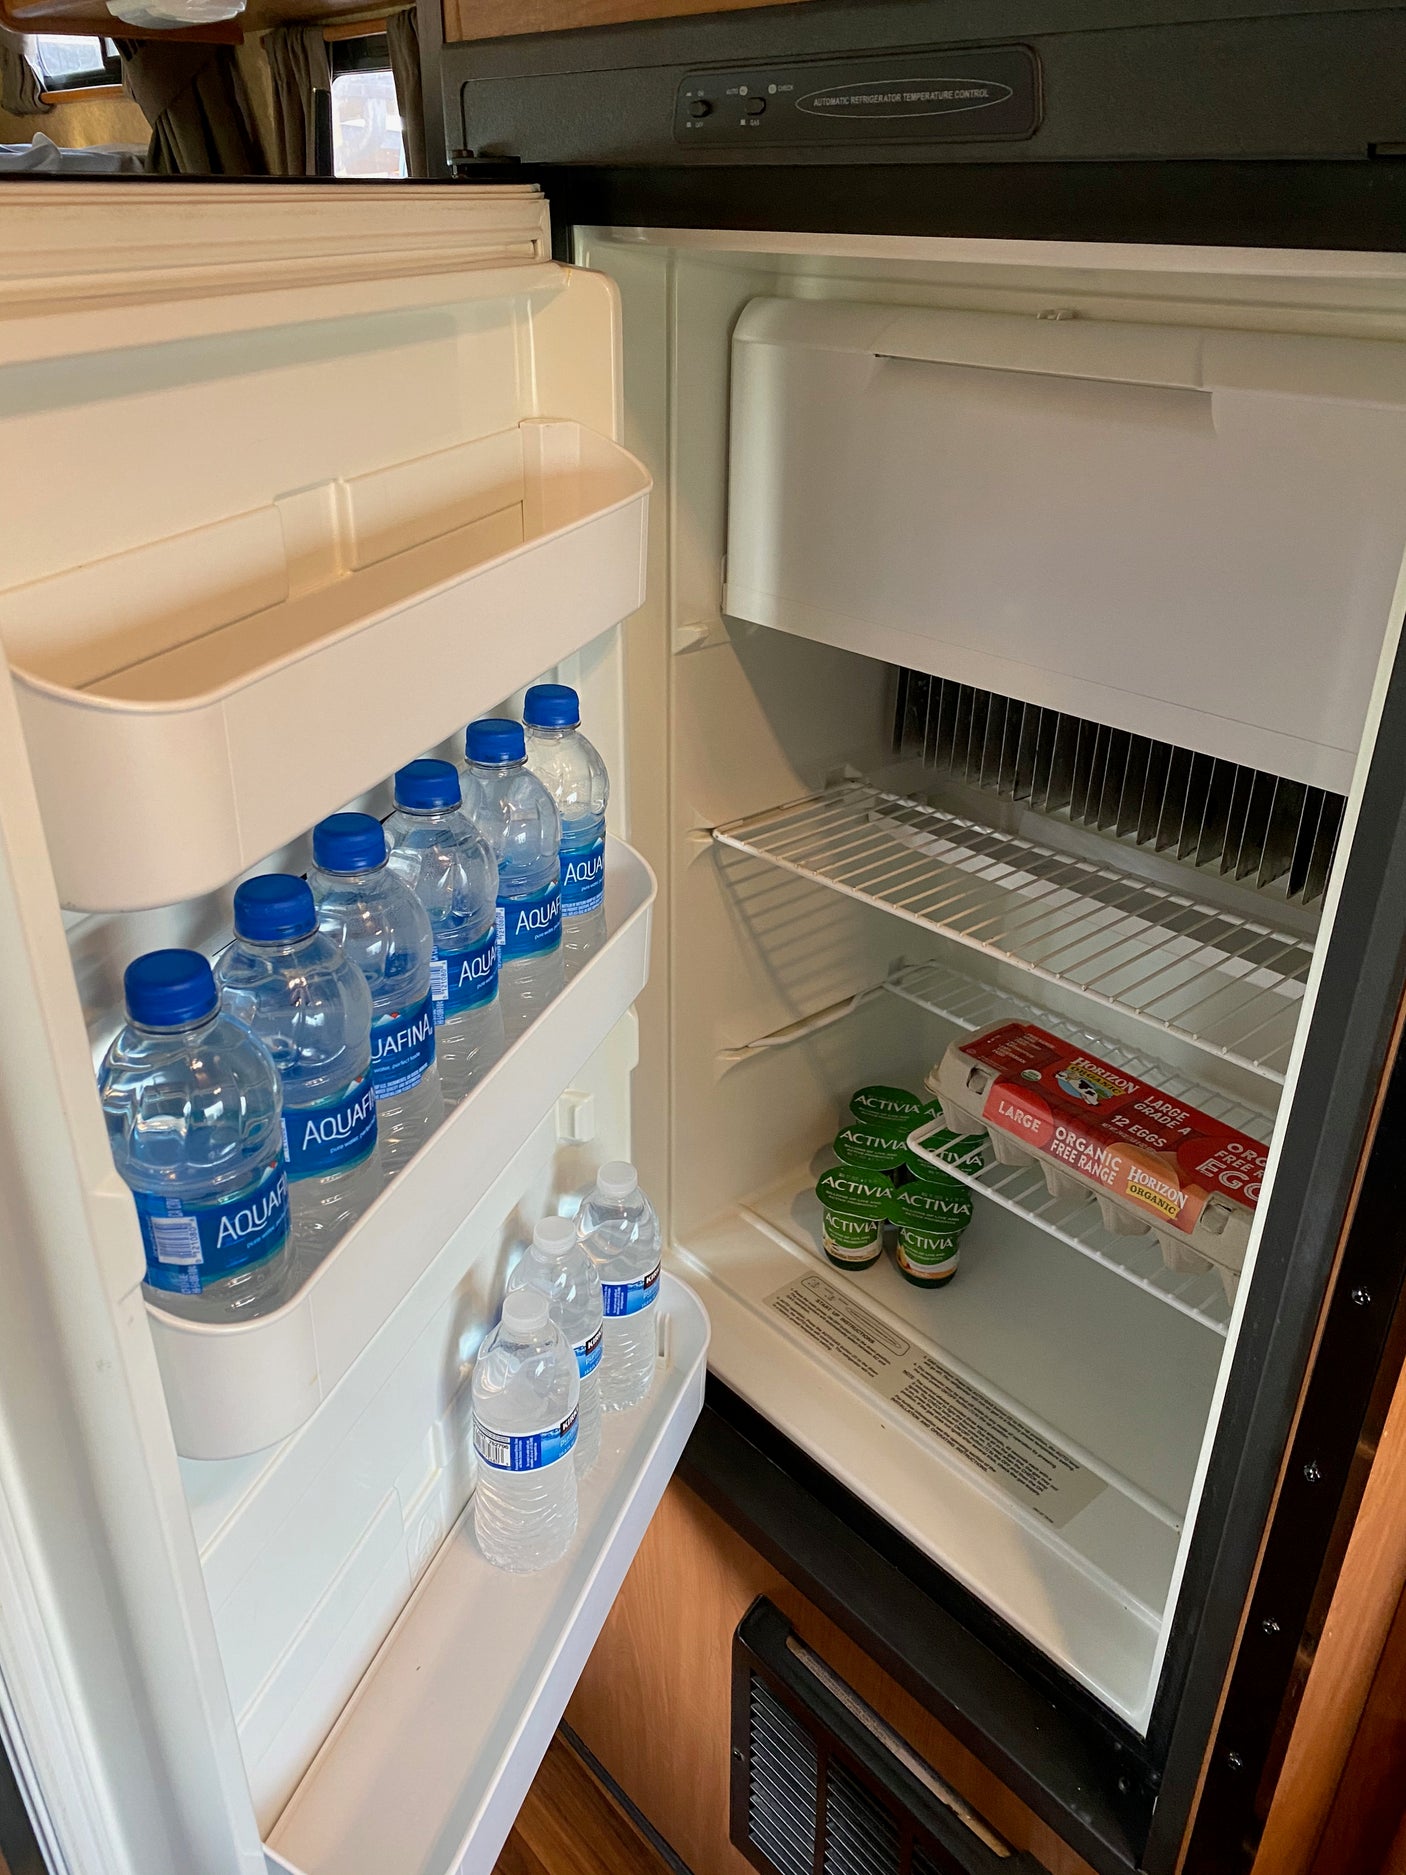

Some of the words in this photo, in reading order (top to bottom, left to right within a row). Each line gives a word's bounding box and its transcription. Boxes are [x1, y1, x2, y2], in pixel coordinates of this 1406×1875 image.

[813, 97, 850, 107] AUTOMATIC
[851, 93, 901, 105] REFRIGERATOR
[902, 90, 954, 102] TEMPERATURE
[955, 88, 989, 99] CONTROL
[563, 855, 603, 887] AQUA
[371, 1013, 432, 1064] UAFINA
[1070, 1057, 1140, 1094] HORIZON
[1070, 1066, 1122, 1095] ORGANIC
[854, 1095, 920, 1113] ACTIVIA
[998, 1101, 1042, 1133] LARGE
[1143, 1096, 1190, 1122] LARGE
[1133, 1103, 1180, 1129] GRADE
[1177, 1127, 1192, 1136] A
[840, 1130, 908, 1151] ACTIVIA
[1111, 1115, 1130, 1127] 12
[1128, 1125, 1168, 1153] EGGS
[1050, 1139, 1078, 1164] FREE
[1077, 1155, 1118, 1185] RANGE
[1055, 1126, 1122, 1172] ORGANIC
[1214, 1151, 1255, 1173] FREE
[1227, 1143, 1267, 1168] ORG
[821, 1176, 892, 1198] ACTIVIA
[1127, 1165, 1189, 1210] HORIZON
[1130, 1185, 1176, 1215] ORGANIC
[897, 1192, 970, 1215] ACTIVIA
[826, 1213, 877, 1233] ACTIVIA
[900, 1228, 953, 1250] ACTIVIA
[840, 1317, 875, 1344] INSTRUCTIONS
